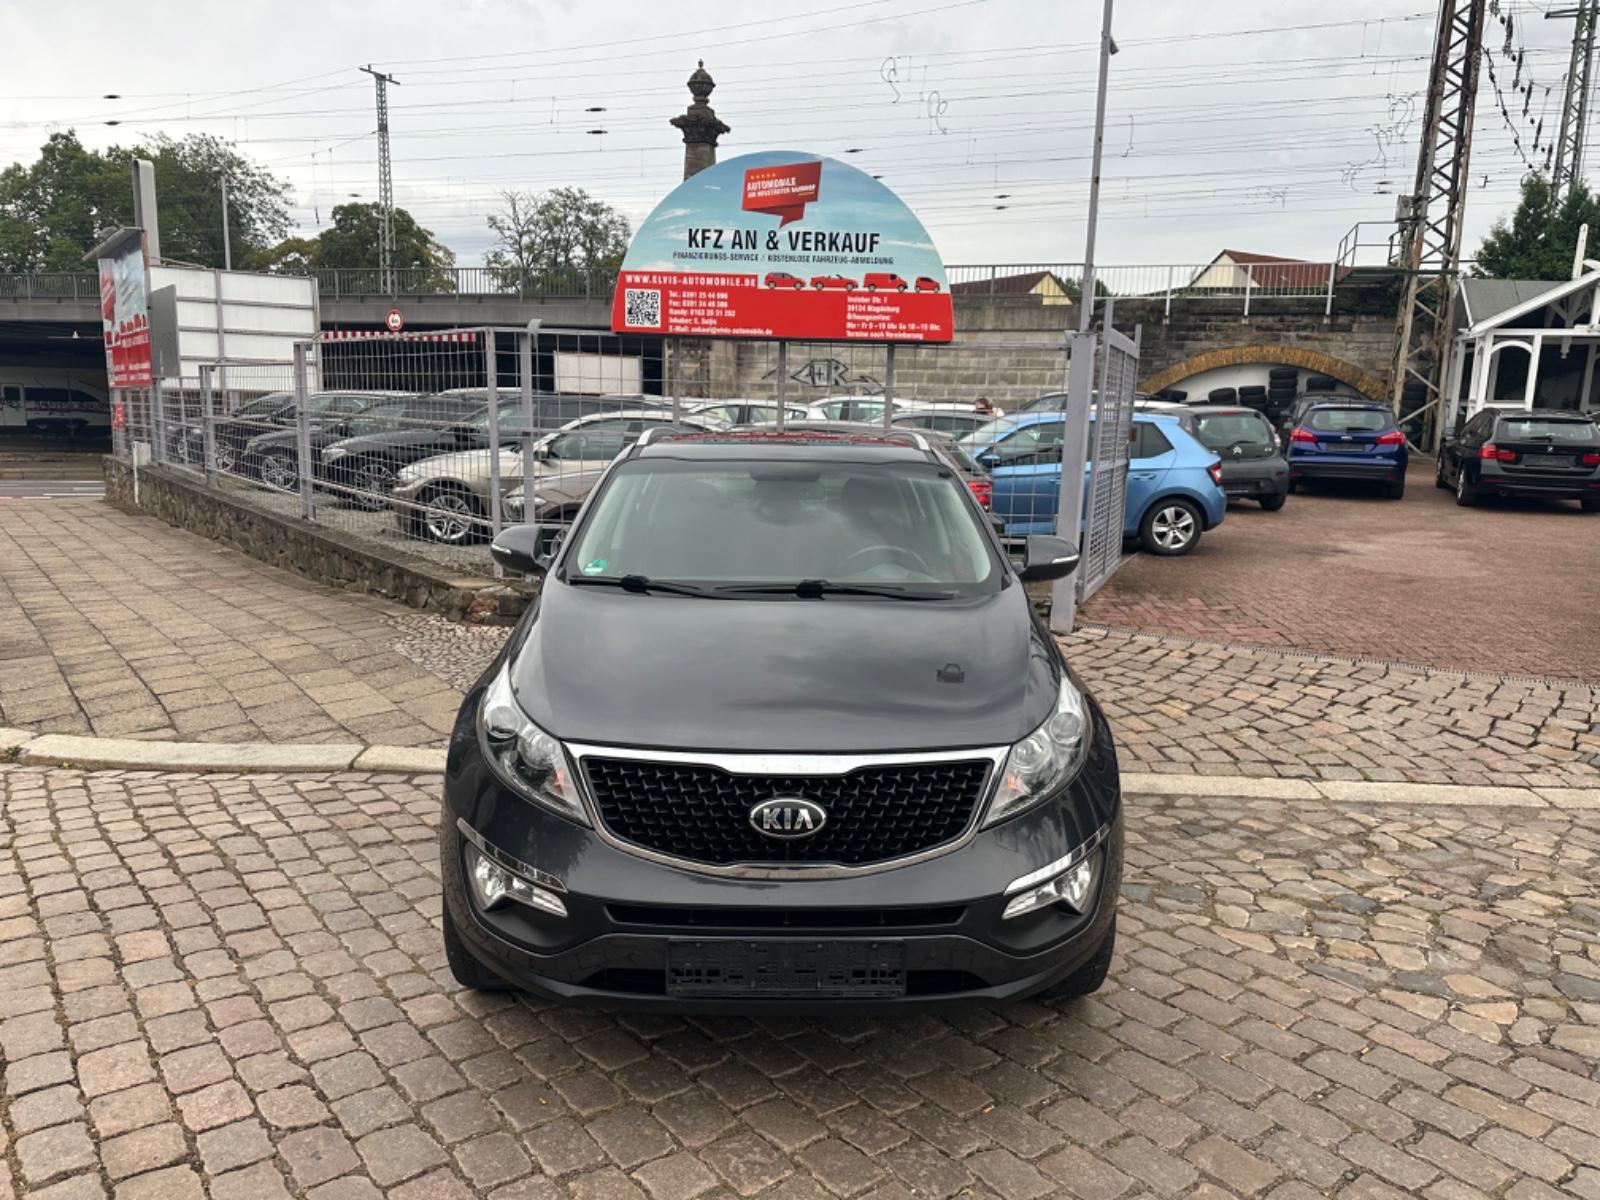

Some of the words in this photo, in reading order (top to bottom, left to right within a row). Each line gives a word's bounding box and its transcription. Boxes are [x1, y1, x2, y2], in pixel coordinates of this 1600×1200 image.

[688, 228, 724, 249] KFZ
[731, 229, 757, 250] AN
[766, 229, 779, 251] &
[788, 231, 880, 253] VERKAUF
[768, 254, 811, 263] KOSTENLOSE
[625, 274, 756, 287] WWW.ELVIS-AUTOMOBILE.DE
[763, 807, 814, 830] KIA
